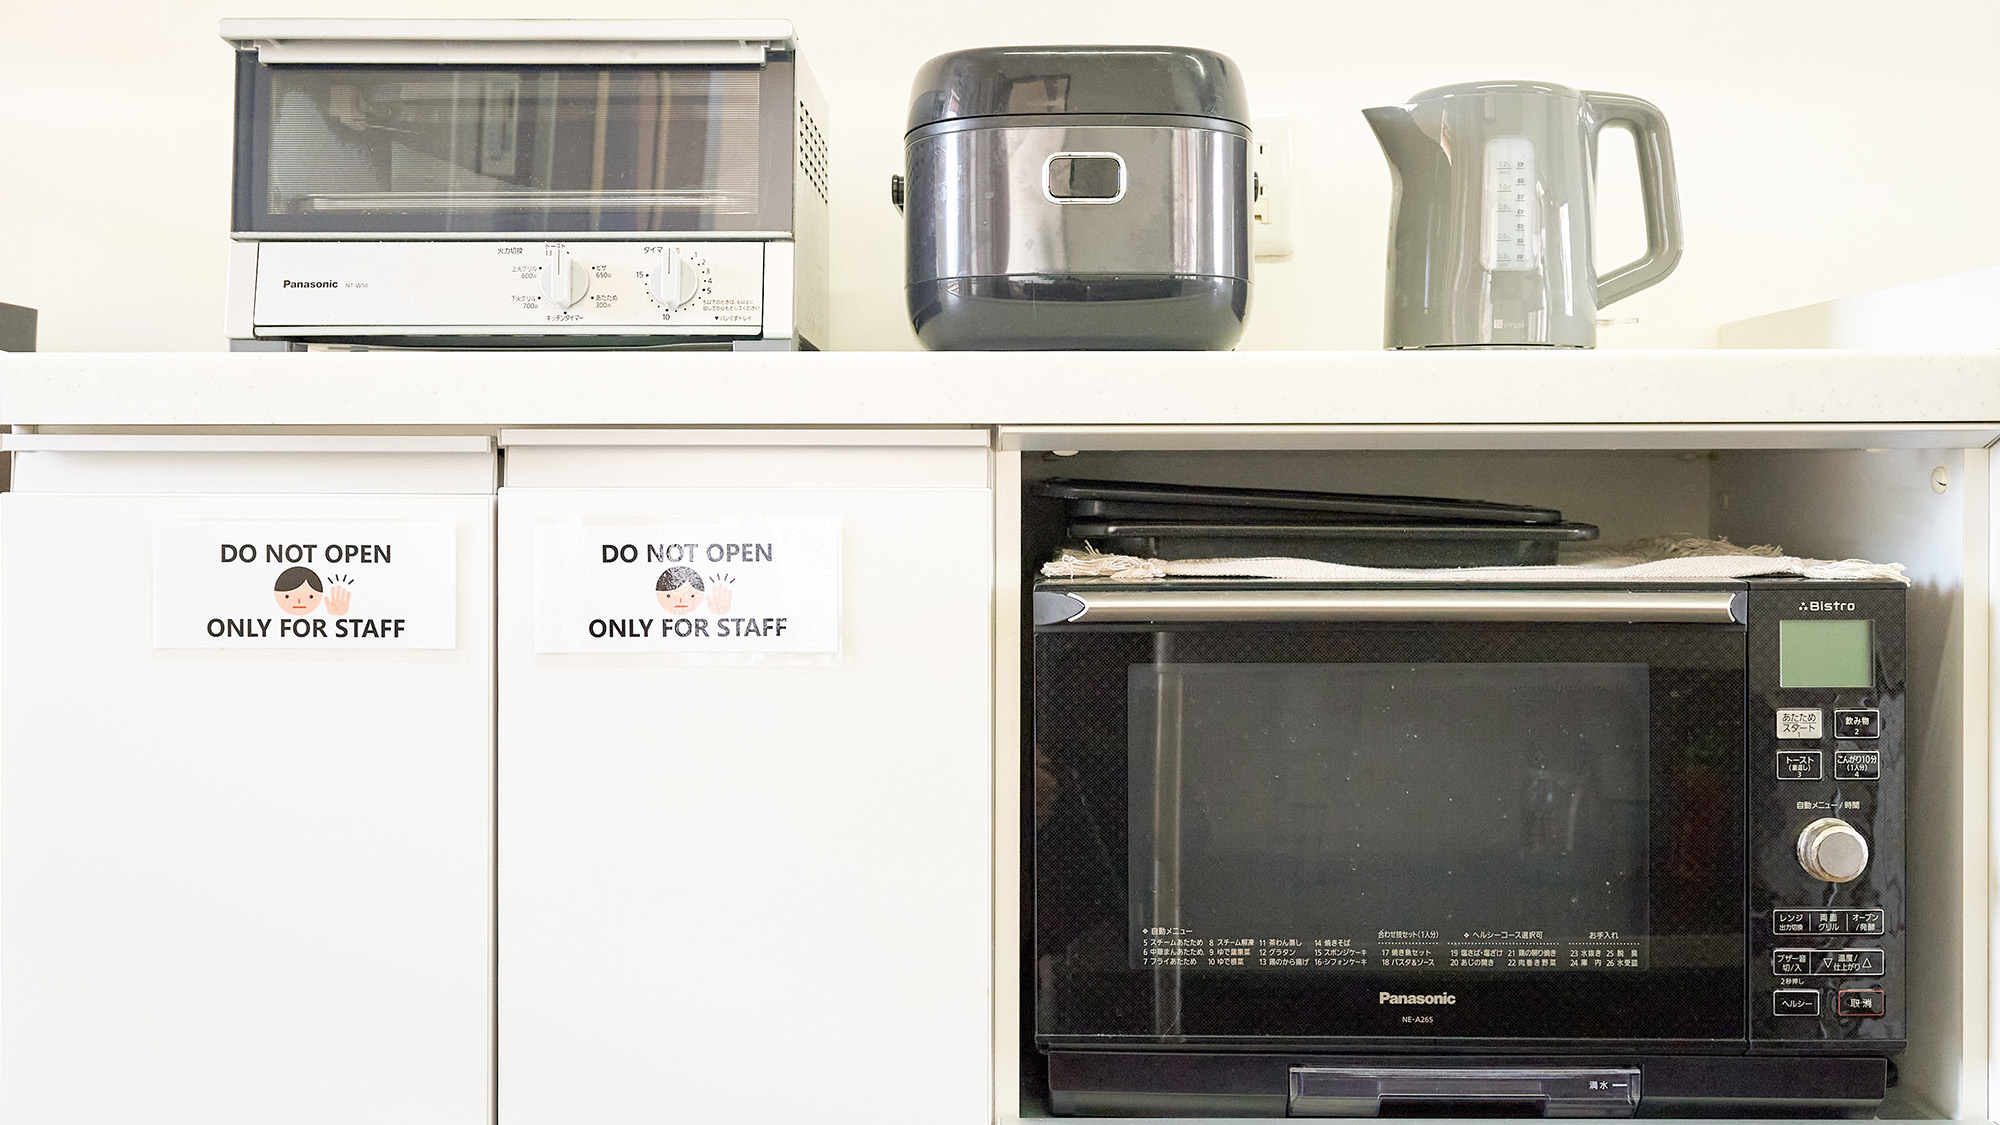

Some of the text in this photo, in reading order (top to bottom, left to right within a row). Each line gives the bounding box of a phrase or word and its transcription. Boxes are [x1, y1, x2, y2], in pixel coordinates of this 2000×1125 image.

[283, 280, 339, 289] Panasonic
[221, 544, 392, 564] DO NOT OPEN
[602, 543, 773, 564] DO NOT OPEN
[1810, 601, 1855, 612] Bistro
[207, 618, 406, 638] ONLY FOR STAFF
[588, 617, 787, 639] ONLY FOR STAFF
[1782, 713, 1816, 722] あたため
[1845, 716, 1870, 726] 飲み物
[1783, 724, 1815, 733] スタート
[1786, 756, 1815, 764] トースト
[1837, 756, 1878, 764] こんがり10分
[1780, 914, 1803, 923] レンジ
[1151, 927, 1193, 936] 自動メニュー
[1473, 931, 1543, 940] ヘルシーコース選択可
[1589, 932, 1619, 940] お手入れ
[1143, 939, 1204, 947] 5 スチームあたため
[1209, 939, 1214, 947] 8
[1259, 939, 1266, 947] 11
[1314, 939, 1322, 947] 14
[1143, 949, 1148, 957] 6
[1209, 949, 1214, 957] 9
[1259, 949, 1296, 957] 12 グラタン
[1314, 949, 1367, 957] 15 スポンジケーキ
[1382, 949, 1390, 958] 17
[1451, 949, 1458, 958] 19
[1508, 949, 1515, 958] 21
[1570, 949, 1579, 958] 23
[1606, 949, 1614, 958] 25
[1143, 958, 1197, 966] 7 フライあたため
[1208, 958, 1216, 966] 10
[1259, 958, 1267, 966] 13
[1314, 958, 1367, 966] 16 シフォンケーキ
[1382, 959, 1390, 968] 18
[1450, 959, 1459, 968] 20
[1508, 959, 1516, 968] 22
[1570, 959, 1579, 968] 24
[1606, 959, 1614, 968] 26
[1379, 992, 1456, 1005] Panasonic
[1782, 1000, 1813, 1008] ヘルシー
